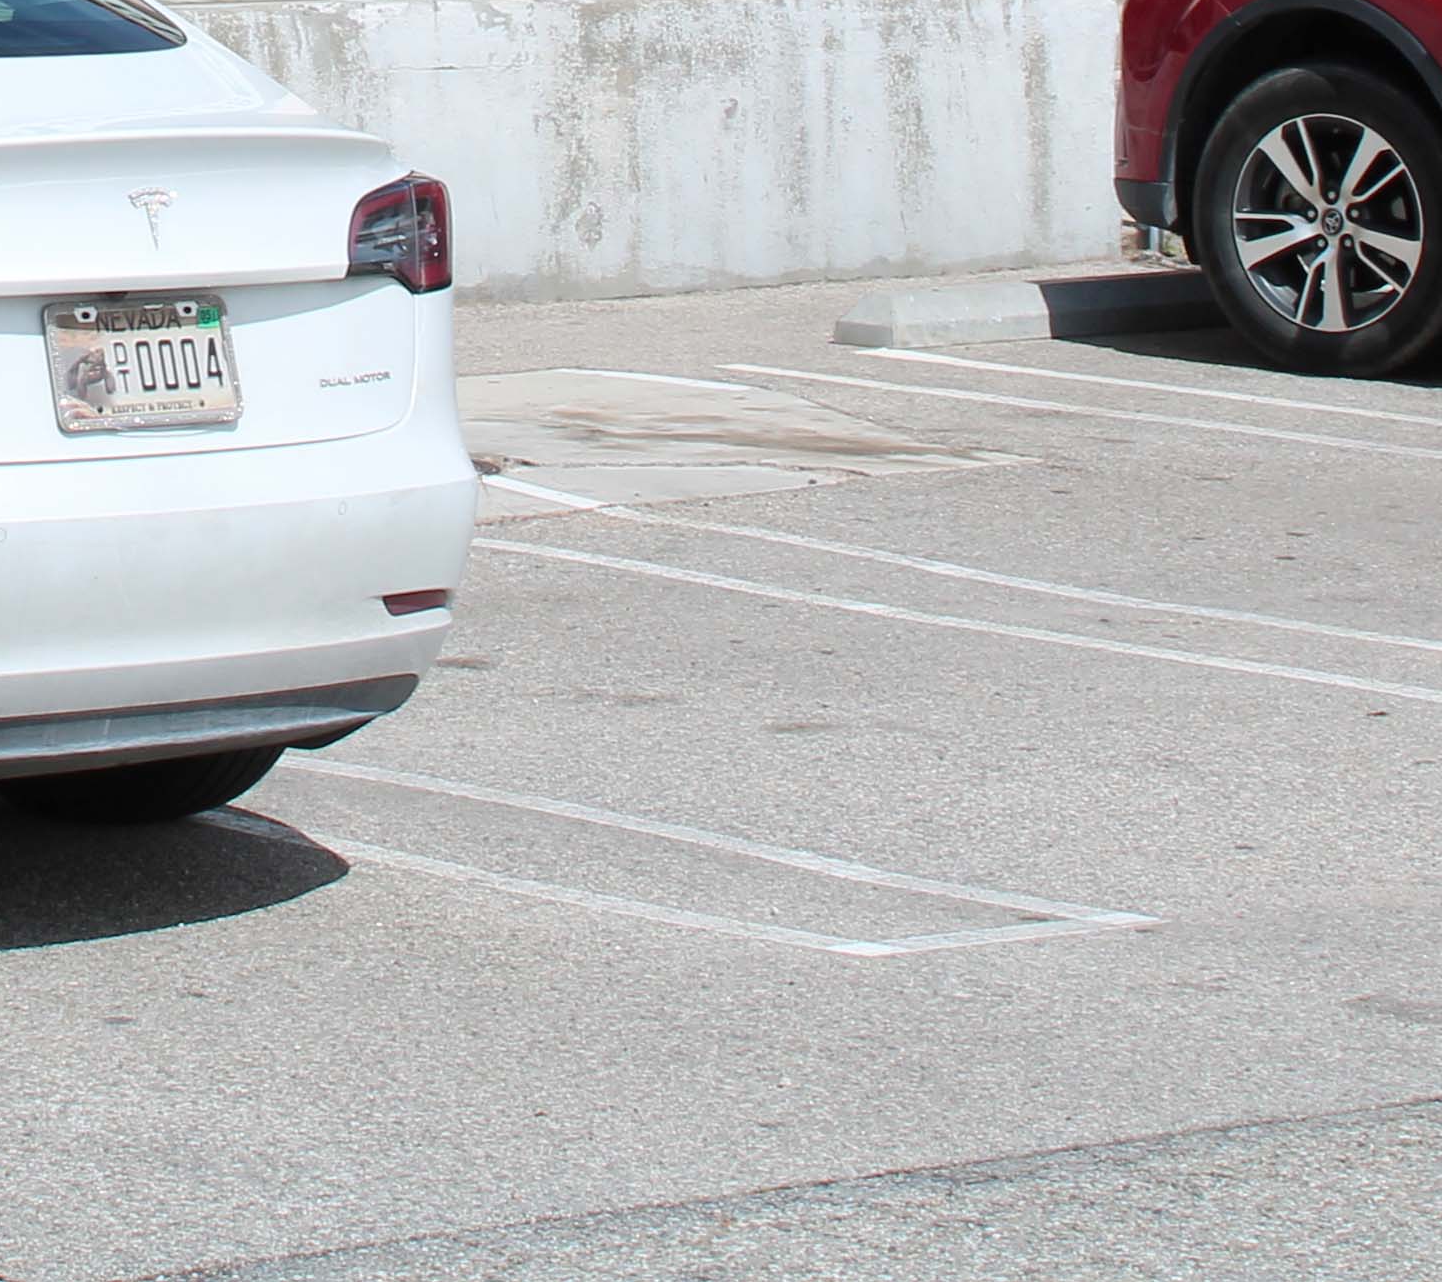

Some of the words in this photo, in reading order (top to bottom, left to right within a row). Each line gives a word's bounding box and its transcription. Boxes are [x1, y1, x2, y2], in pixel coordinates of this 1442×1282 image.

[96, 309, 182, 333] NEVADA
[319, 377, 352, 388] DUAL
[353, 370, 392, 384] MOTOR
